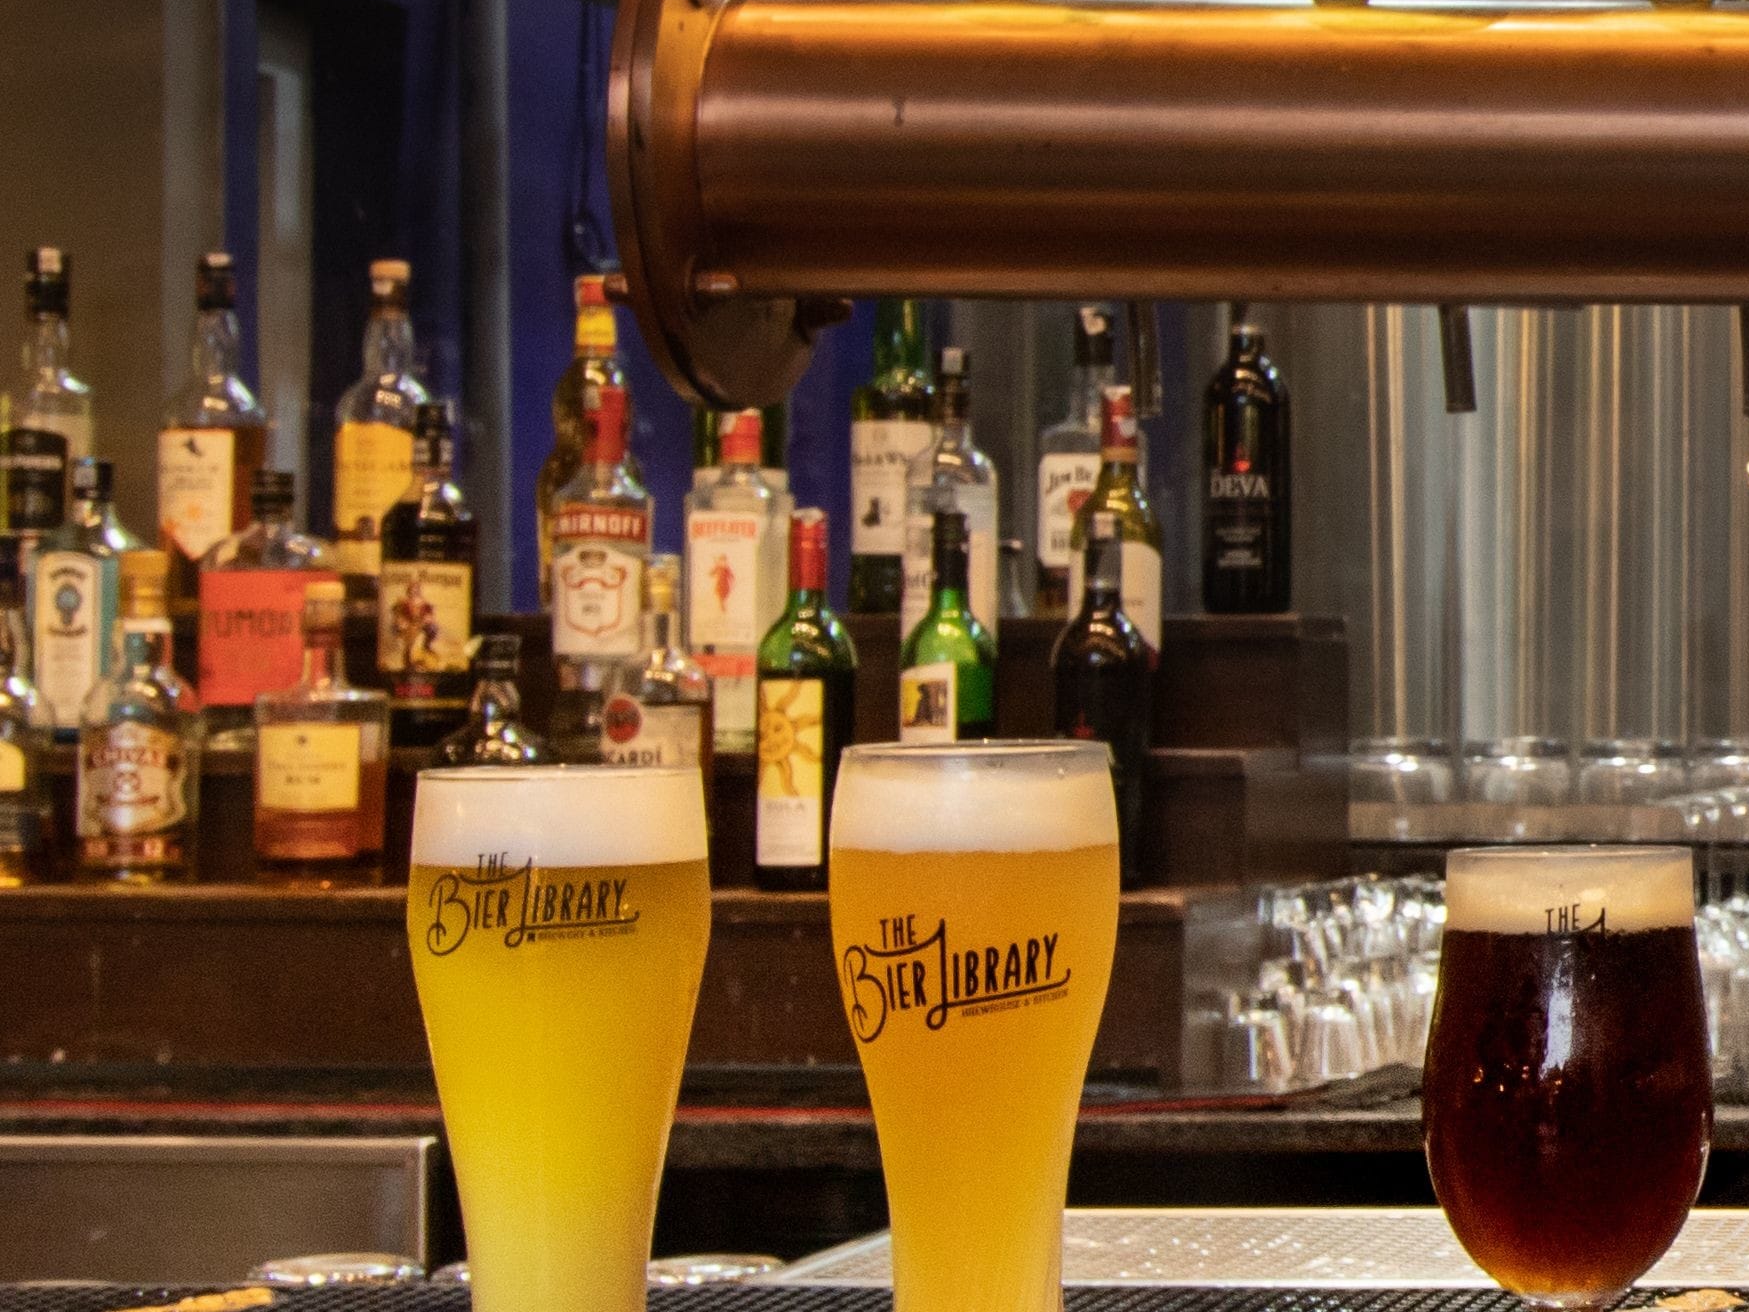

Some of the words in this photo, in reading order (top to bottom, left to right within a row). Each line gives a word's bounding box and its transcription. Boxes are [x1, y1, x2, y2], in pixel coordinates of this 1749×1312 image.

[551, 513, 642, 537] MIRNOFF
[476, 850, 509, 877] THE
[426, 873, 511, 957] BIER
[504, 856, 640, 948] LIBRARY
[1545, 903, 1581, 935] THE
[880, 914, 917, 950] THE
[843, 945, 927, 1043] BIER
[925, 917, 1072, 1030] LIBRARY
